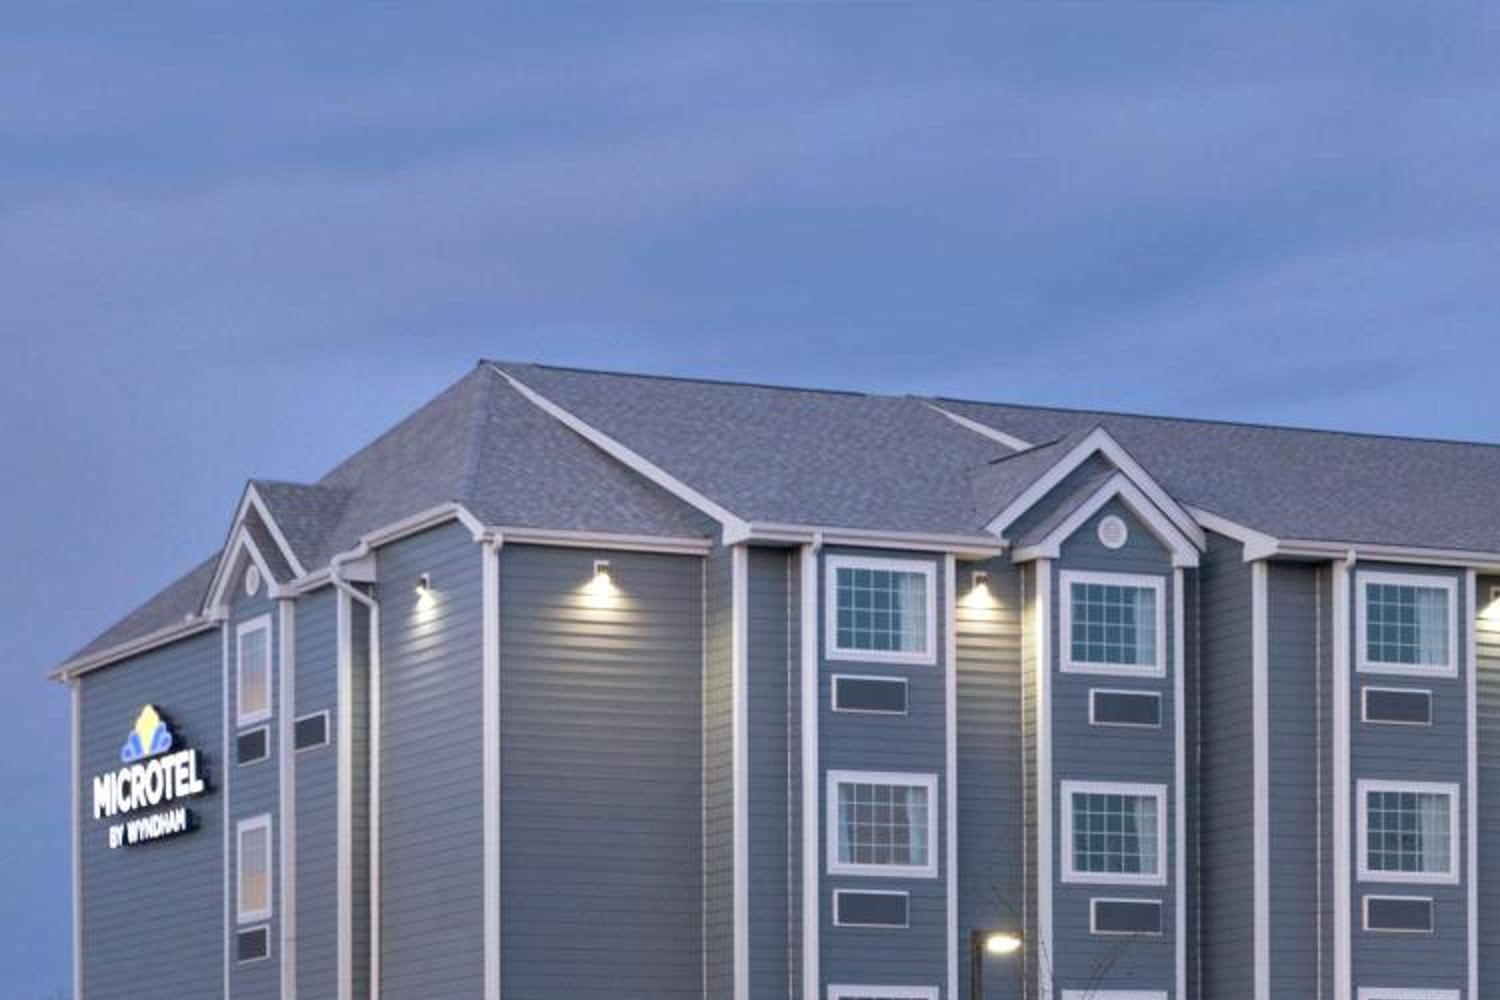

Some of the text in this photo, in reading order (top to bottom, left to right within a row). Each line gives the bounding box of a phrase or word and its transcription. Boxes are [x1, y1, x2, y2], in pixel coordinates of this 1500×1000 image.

[93, 748, 204, 819] MICROTEL
[109, 808, 186, 848] BY WYNDHAM
